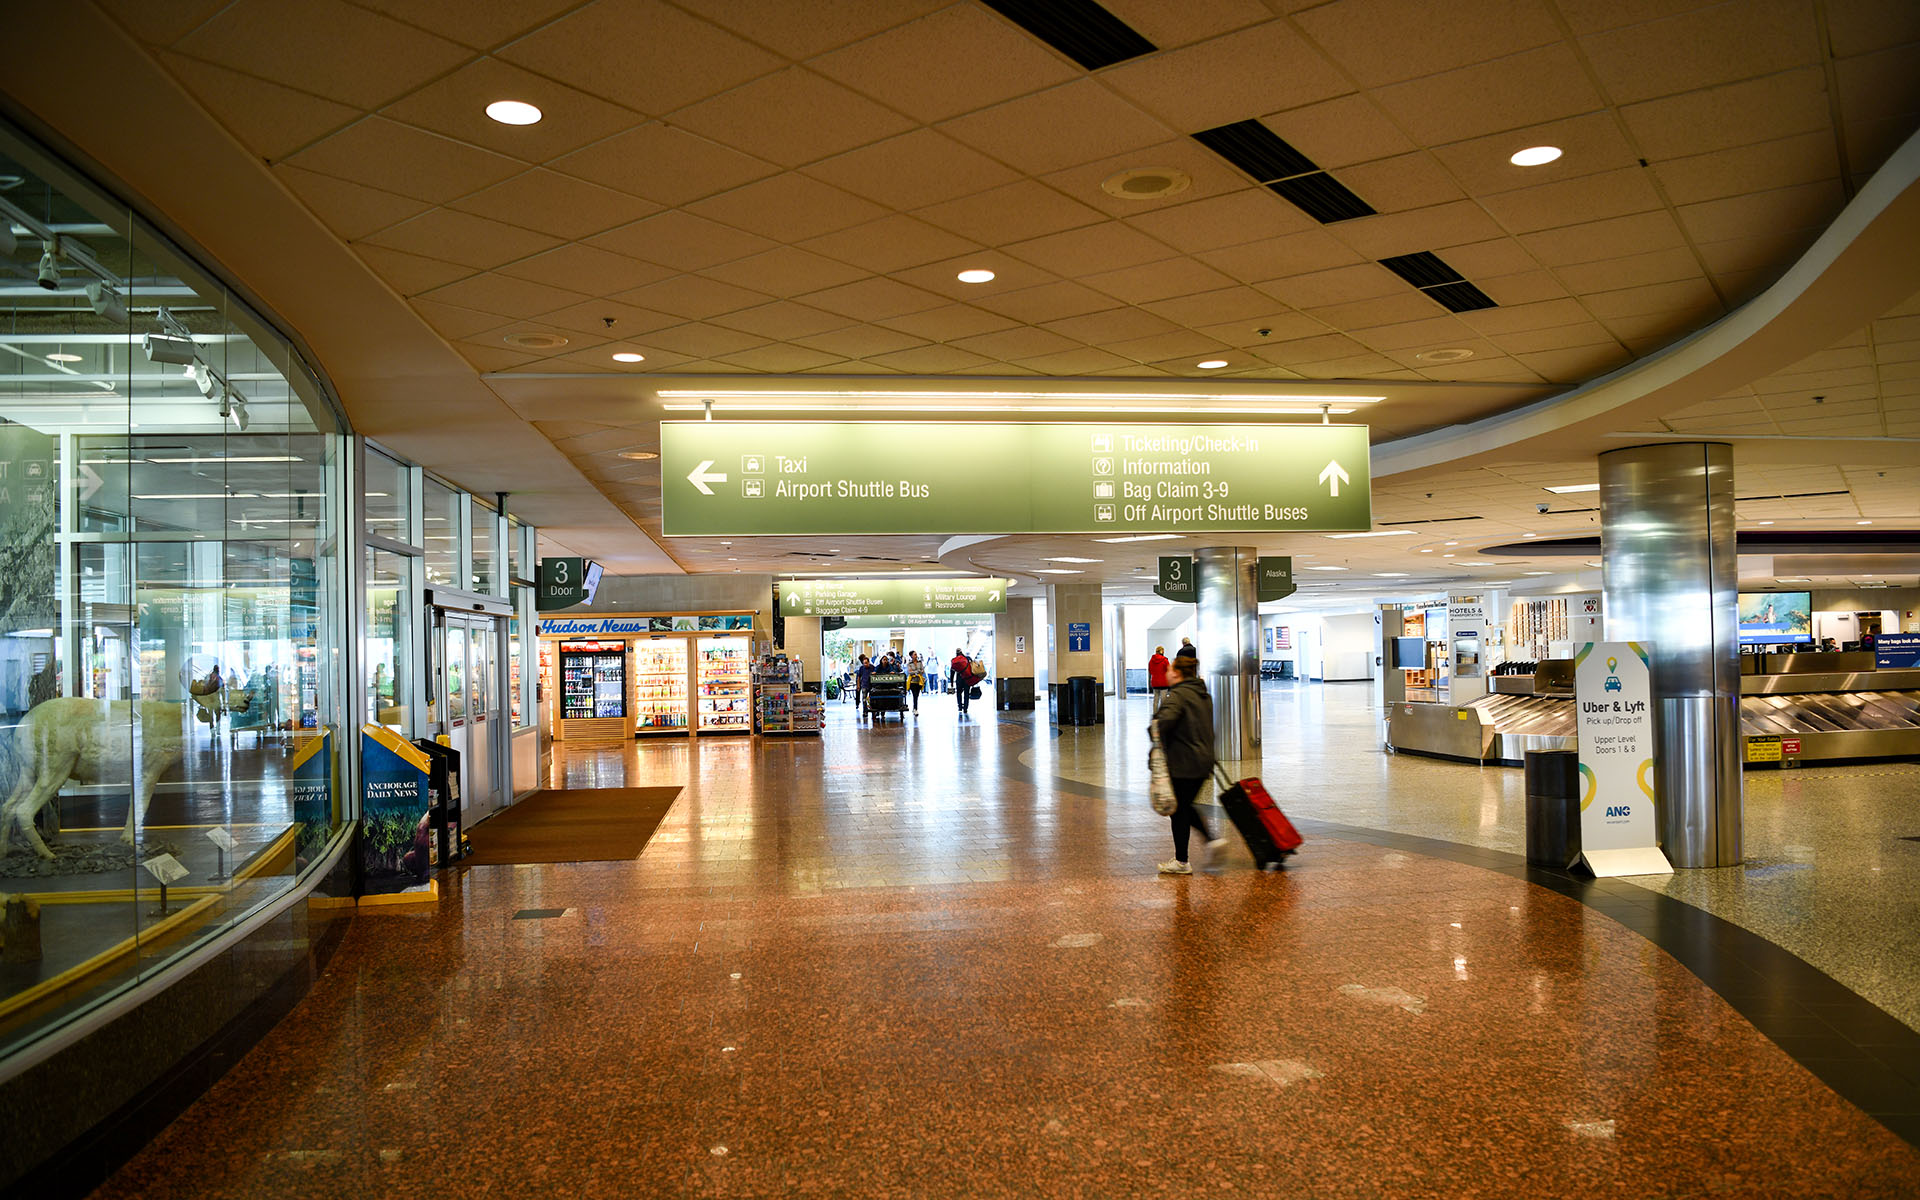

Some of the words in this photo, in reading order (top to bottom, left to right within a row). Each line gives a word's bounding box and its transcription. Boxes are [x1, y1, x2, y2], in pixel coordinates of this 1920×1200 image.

[775, 456, 807, 473] Taxi
[1123, 458, 1210, 475] Information
[775, 480, 832, 500] Airport
[837, 480, 894, 497] Shuttle
[900, 480, 930, 498] Bus
[1123, 481, 1151, 501] Bag
[1157, 481, 1199, 498] Claim
[1203, 481, 1229, 499] 3-9
[1124, 504, 1147, 521] Off
[1151, 505, 1203, 524] Airport
[1208, 504, 1259, 521] Shuttle
[1264, 504, 1308, 521] Buses
[555, 561, 568, 584] 3
[1170, 560, 1181, 581] 3
[1265, 569, 1287, 578] Alaska
[550, 585, 574, 596] Door
[1164, 581, 1188, 591] Claim
[825, 599, 845, 607] Airport
[542, 620, 598, 634] Hudson
[599, 620, 648, 634] News
[1583, 702, 1610, 713] Uber
[1613, 701, 1622, 712] &
[1625, 701, 1645, 714] Lyft
[1587, 716, 1601, 725] Pick
[1603, 715, 1631, 726] up/Drop
[1633, 716, 1642, 724] off
[1594, 736, 1616, 745] Upper
[1618, 735, 1636, 743] Level
[1596, 746, 1616, 754] Doors
[1624, 745, 1630, 753] &
[1631, 745, 1636, 753] 8
[367, 781, 417, 790] ANCHORAGE
[367, 790, 392, 799] DAILY
[394, 789, 418, 797] NEWS
